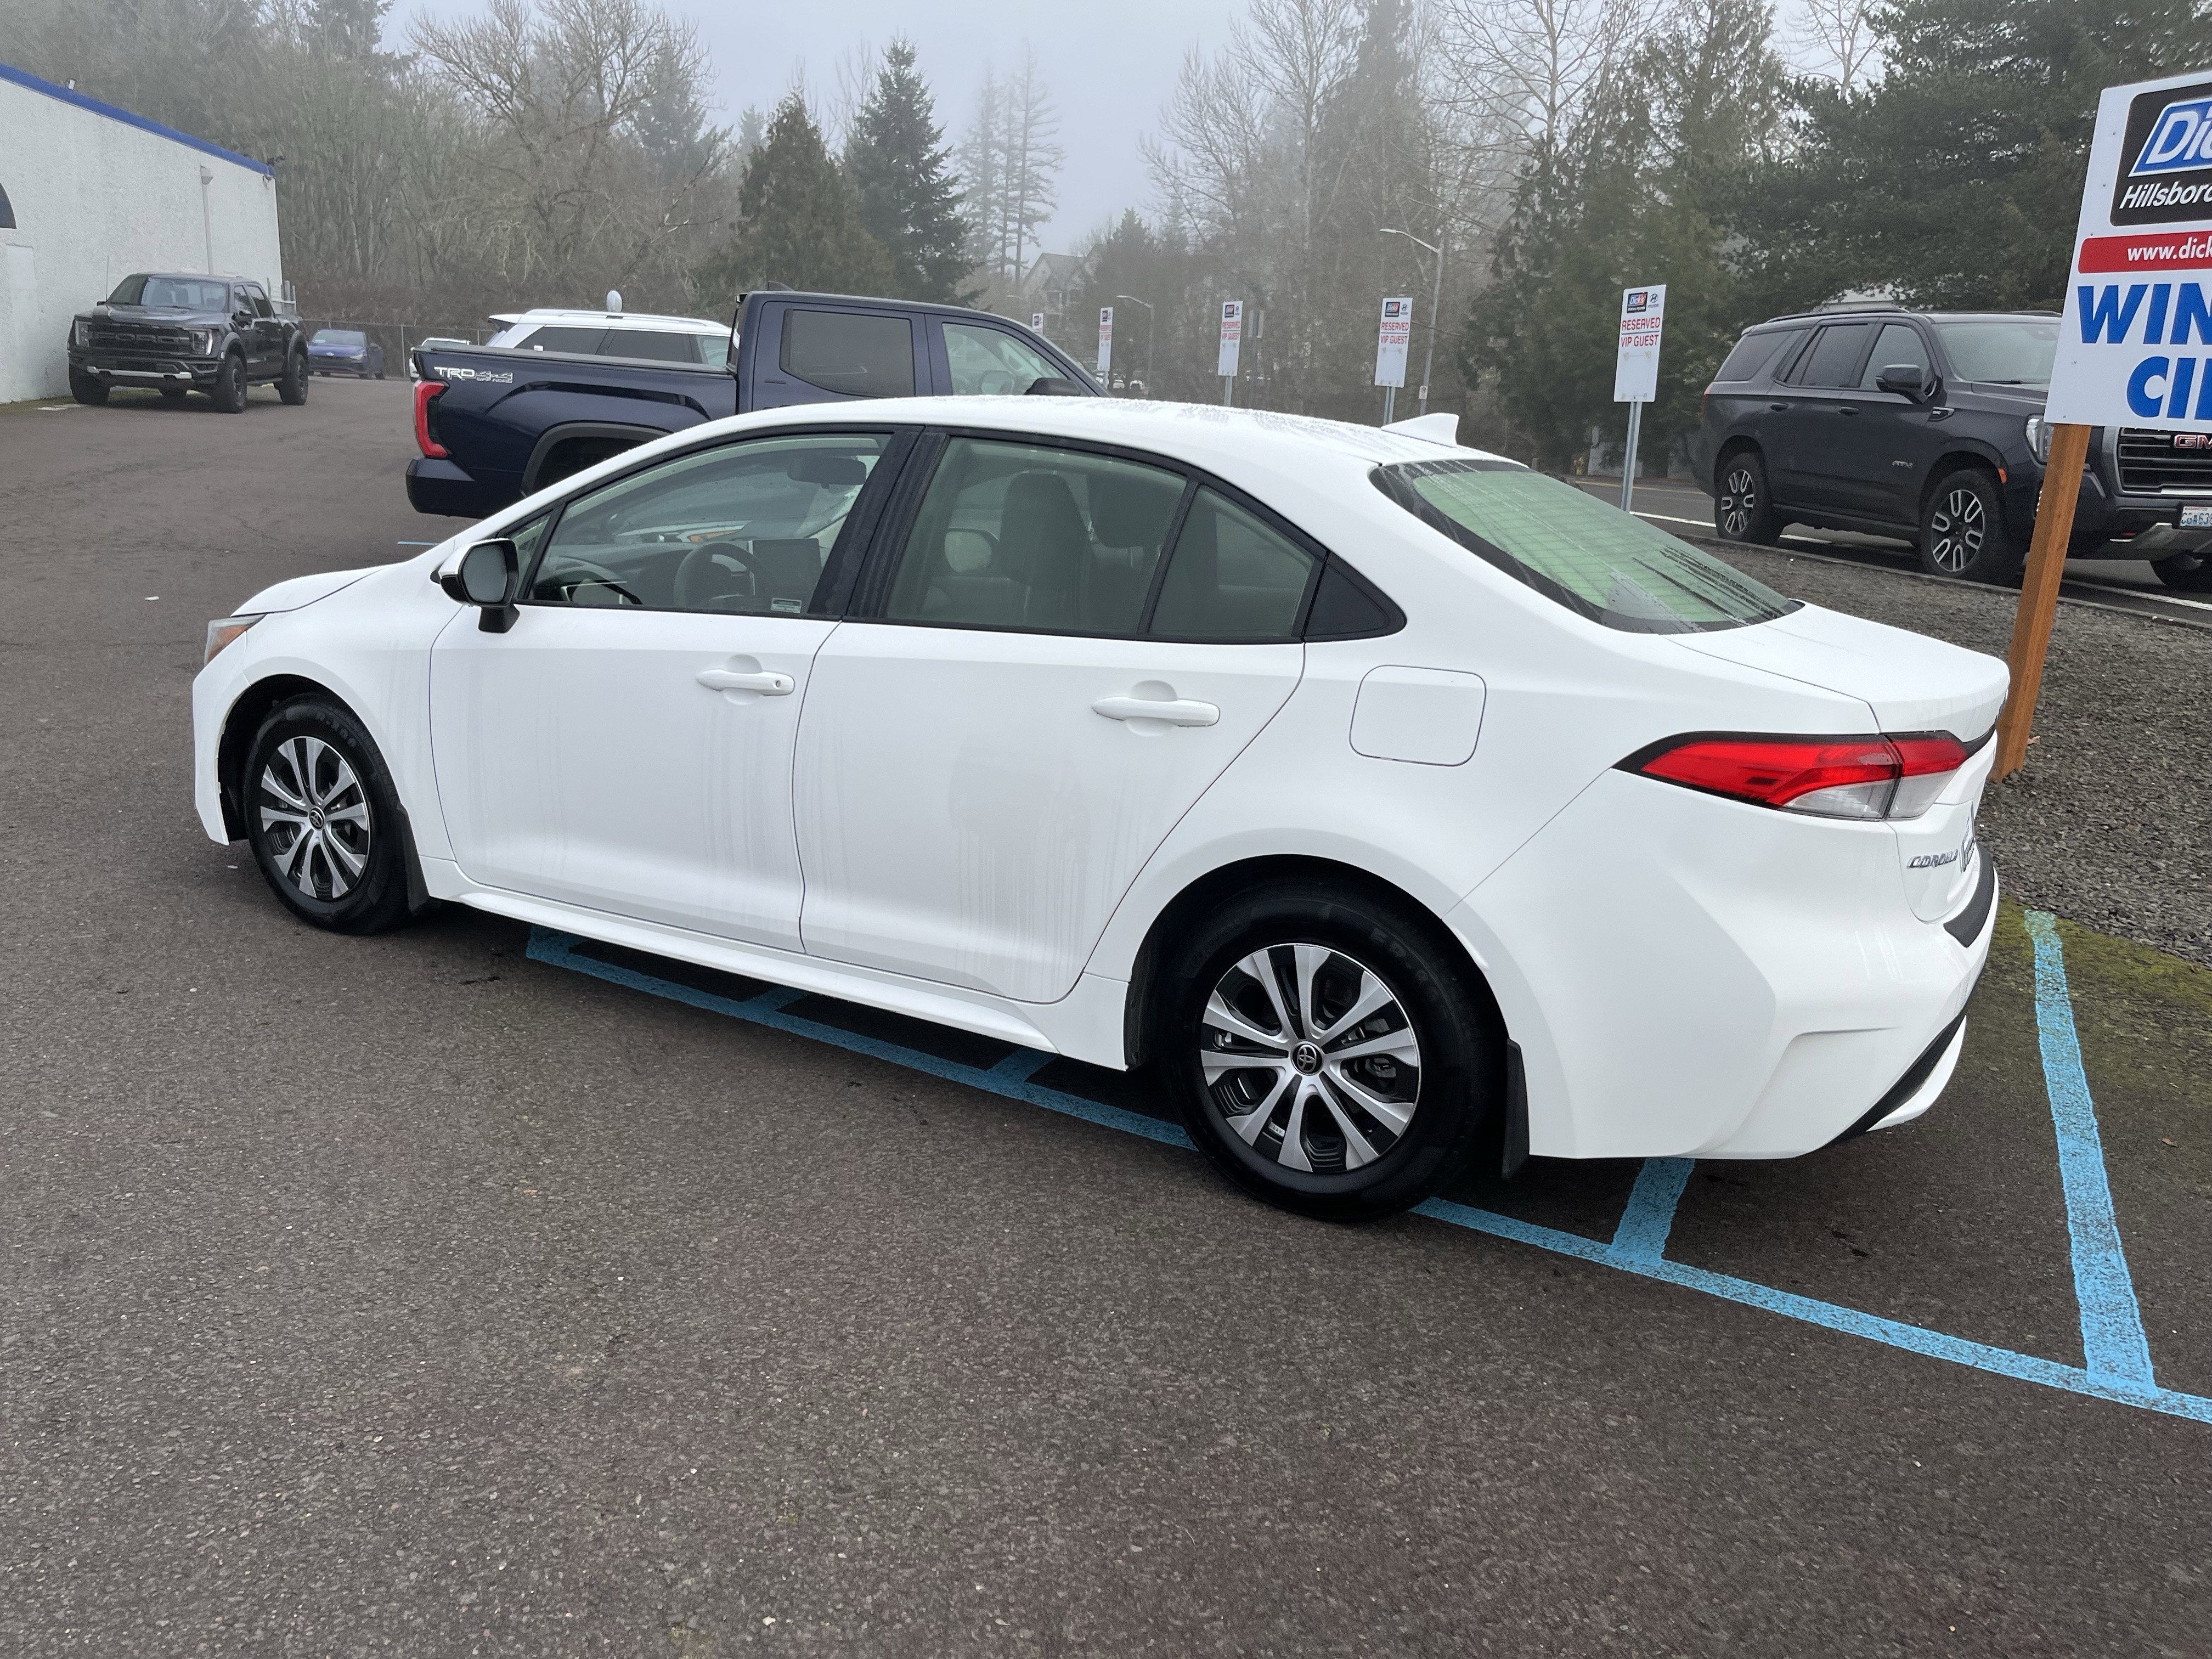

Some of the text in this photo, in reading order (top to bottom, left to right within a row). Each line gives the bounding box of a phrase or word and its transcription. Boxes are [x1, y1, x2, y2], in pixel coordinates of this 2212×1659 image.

[1381, 322, 1409, 331] RESERVED
[1622, 317, 1661, 331] RESERVED
[1380, 335, 1408, 345] VIP GUEST
[1621, 334, 1659, 347] VIP GUEST
[433, 366, 476, 380] TRD
